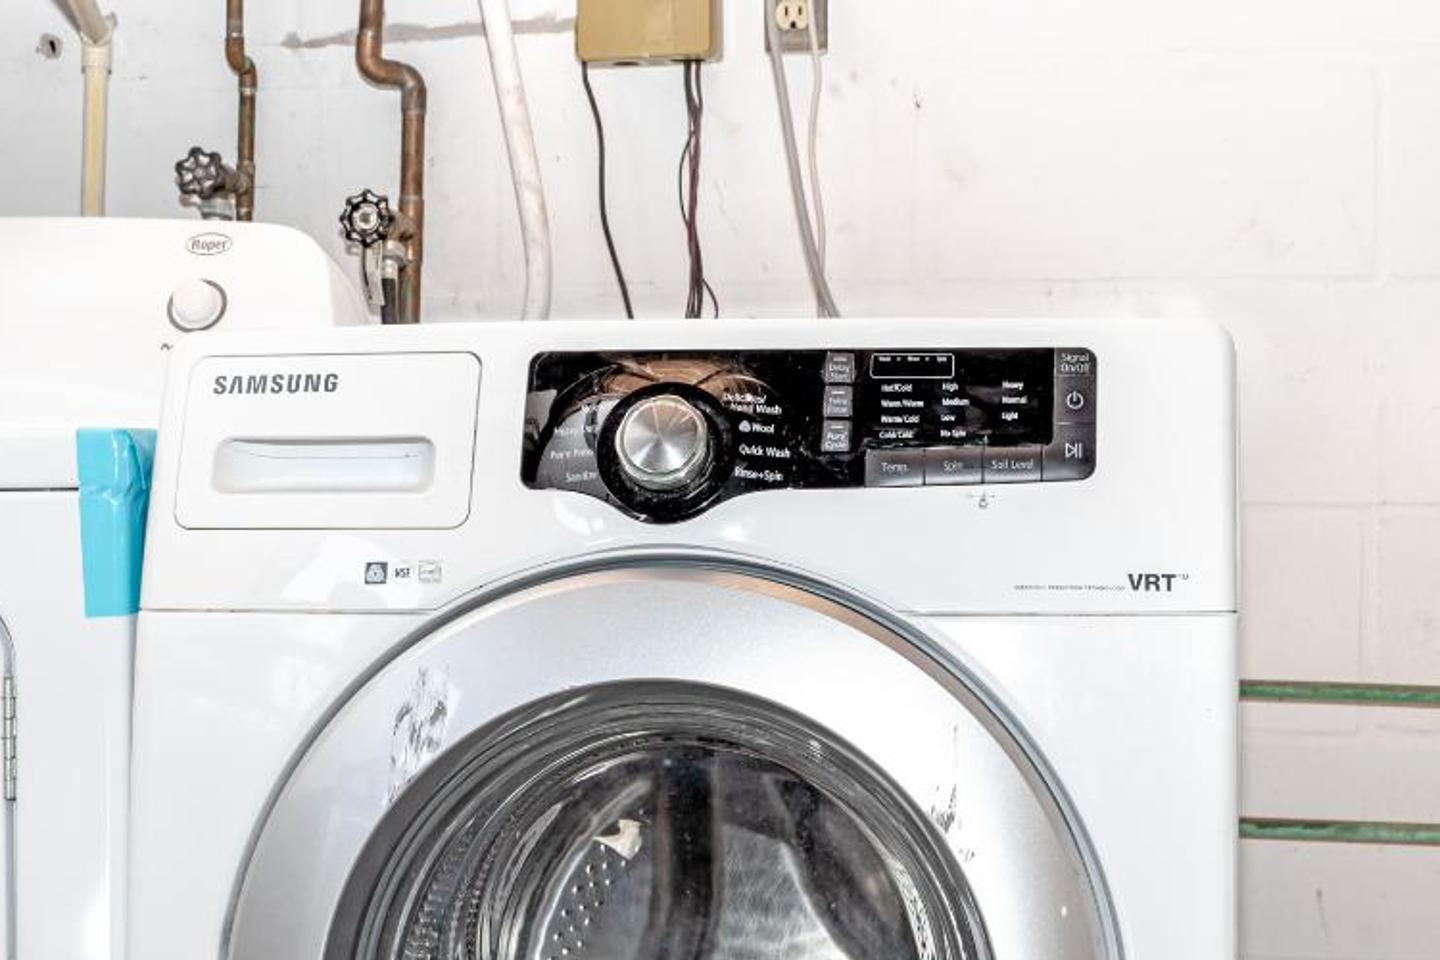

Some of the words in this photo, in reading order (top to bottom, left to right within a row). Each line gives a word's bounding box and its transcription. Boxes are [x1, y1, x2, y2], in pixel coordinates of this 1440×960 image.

[213, 373, 339, 394] SAMSUNG
[756, 404, 782, 415] Wash
[752, 422, 775, 434] Wool
[739, 443, 764, 456] Quick
[766, 447, 791, 458] Wash
[1128, 573, 1177, 592] VRT
